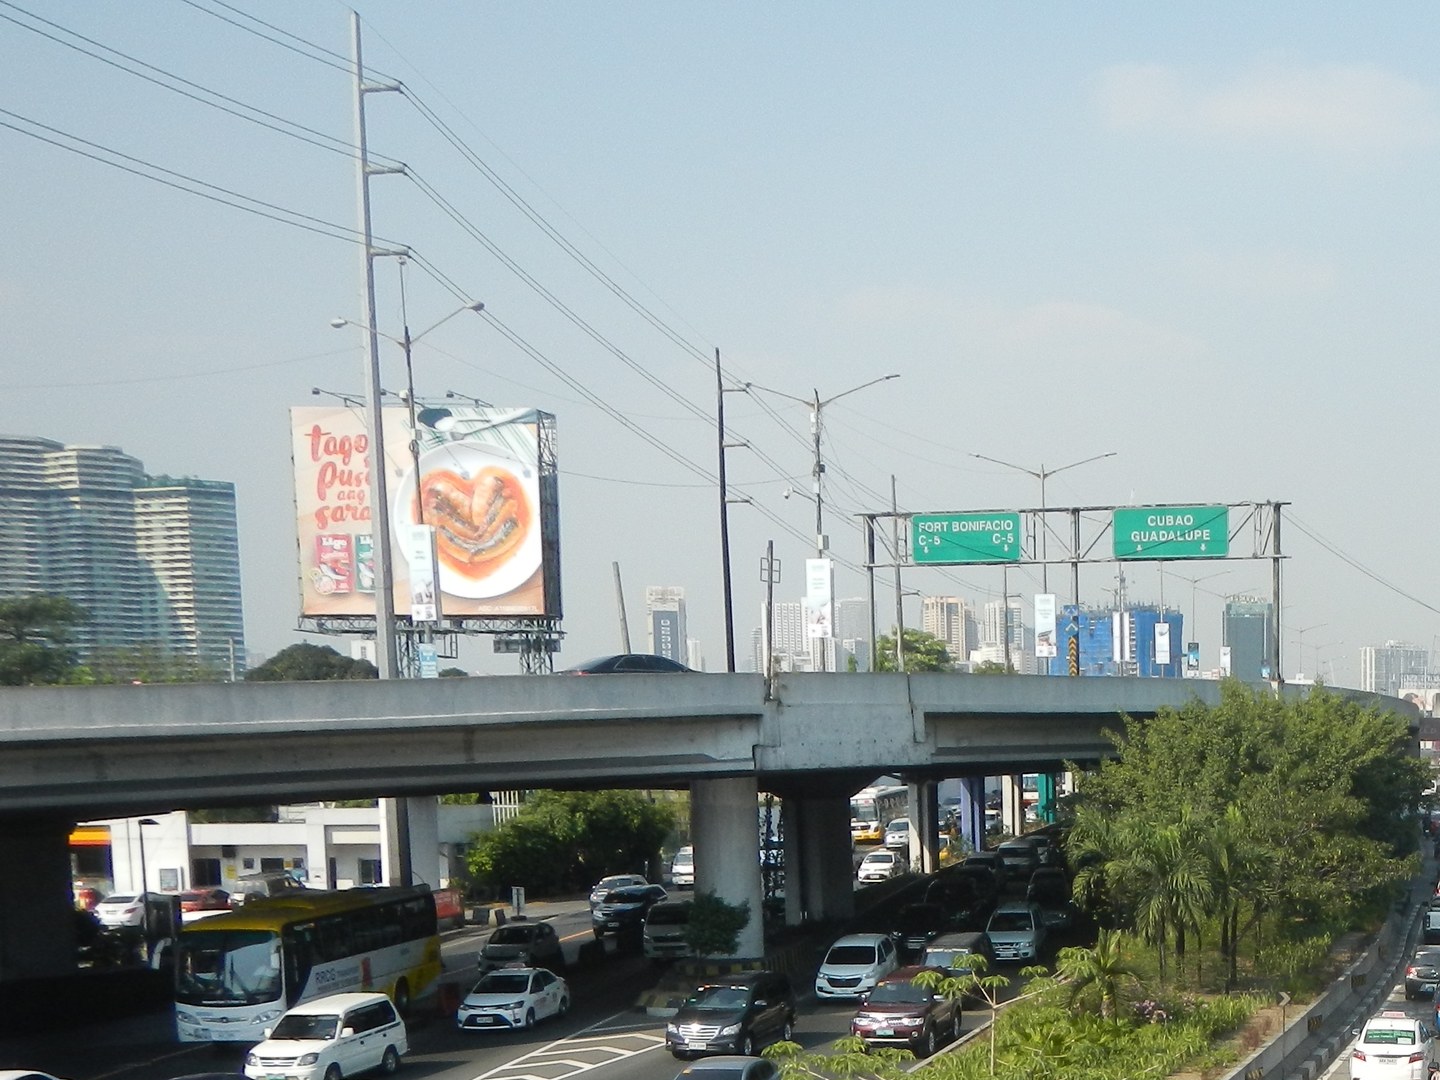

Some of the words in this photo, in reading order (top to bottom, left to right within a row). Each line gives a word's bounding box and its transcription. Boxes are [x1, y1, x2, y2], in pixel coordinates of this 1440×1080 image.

[919, 522, 948, 532] FORT
[952, 520, 1013, 532] BONIFACIO
[1147, 514, 1193, 526] CUBAO
[1131, 529, 1211, 542] GUADALUPE
